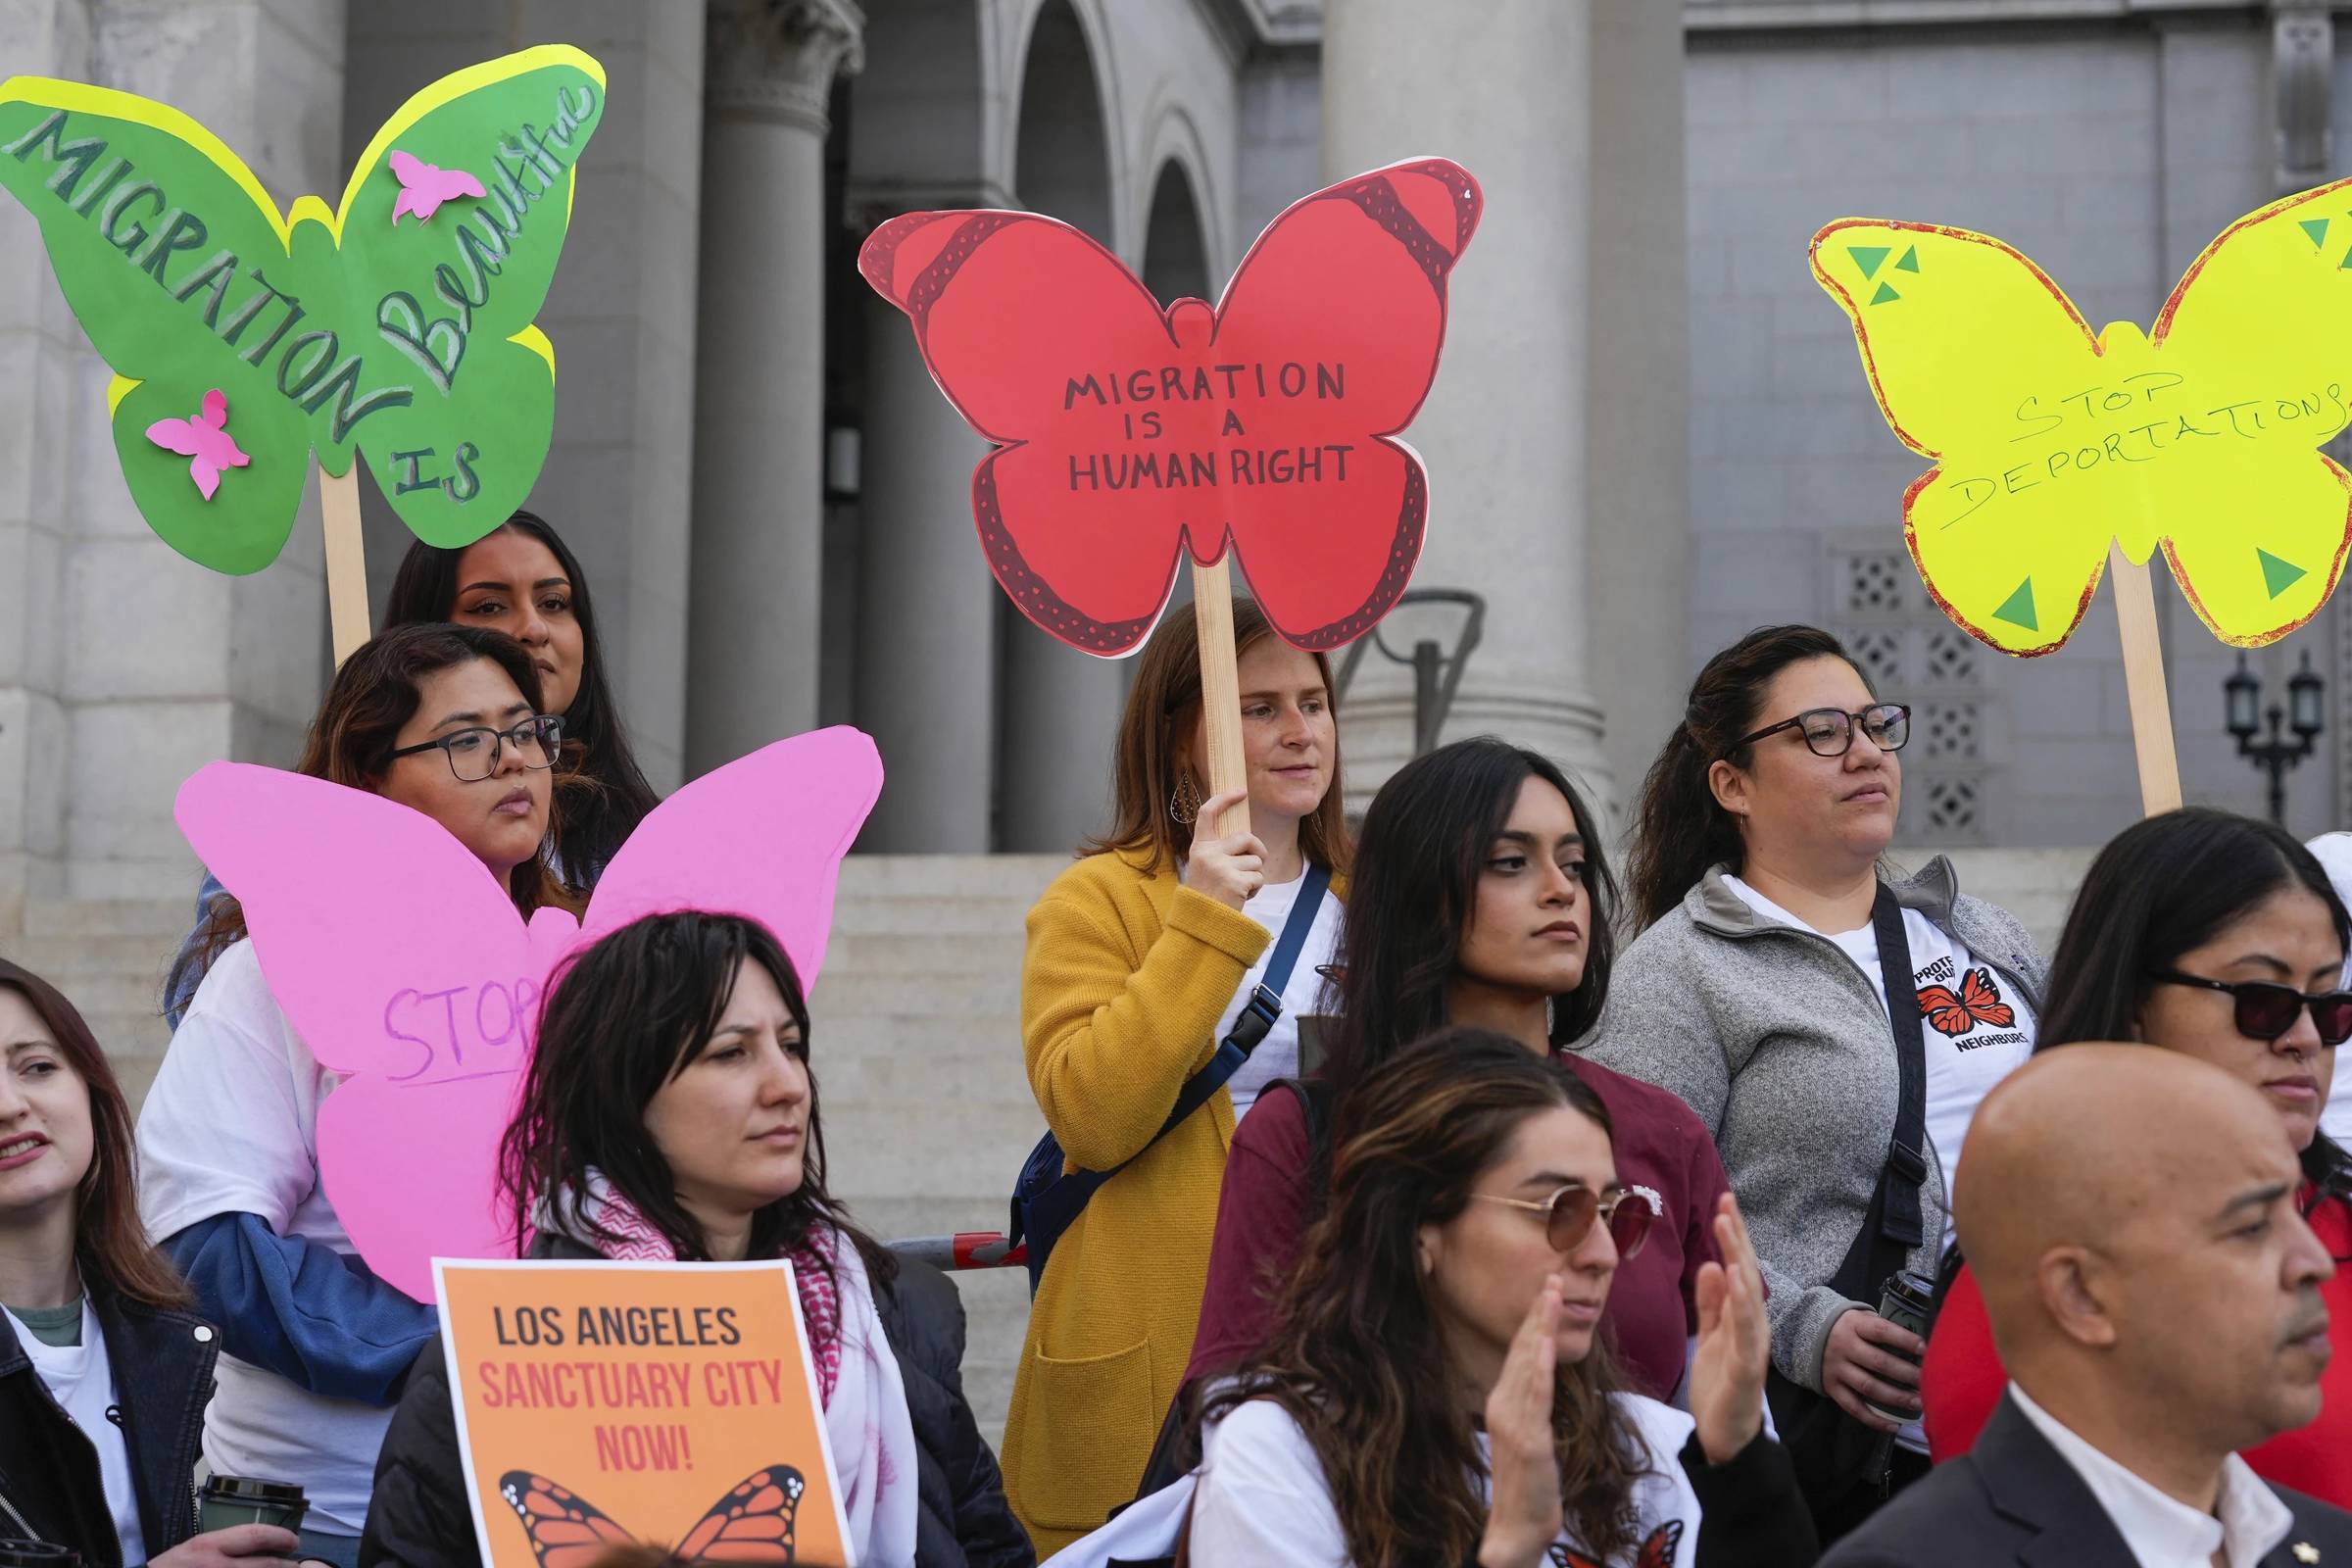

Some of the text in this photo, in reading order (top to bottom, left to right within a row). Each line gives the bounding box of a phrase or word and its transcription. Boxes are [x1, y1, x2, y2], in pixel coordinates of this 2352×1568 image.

[1, 109, 414, 445] MIGRATION
[1064, 362, 1345, 410] MIGRATION
[2008, 371, 2183, 443] STOP
[1124, 408, 1246, 440] IS A
[389, 441, 480, 505] IS
[1069, 445, 1354, 491] HUMAN RIGHT
[1939, 383, 2347, 530] DEPORTATIONS
[383, 977, 539, 1083] STOP
[1955, 1032, 2029, 1053] NEIGHBORS
[493, 1305, 742, 1347] LOS ANGELES
[477, 1358, 783, 1409] SANCTUARY CITY
[594, 1424, 694, 1472] NOW!
